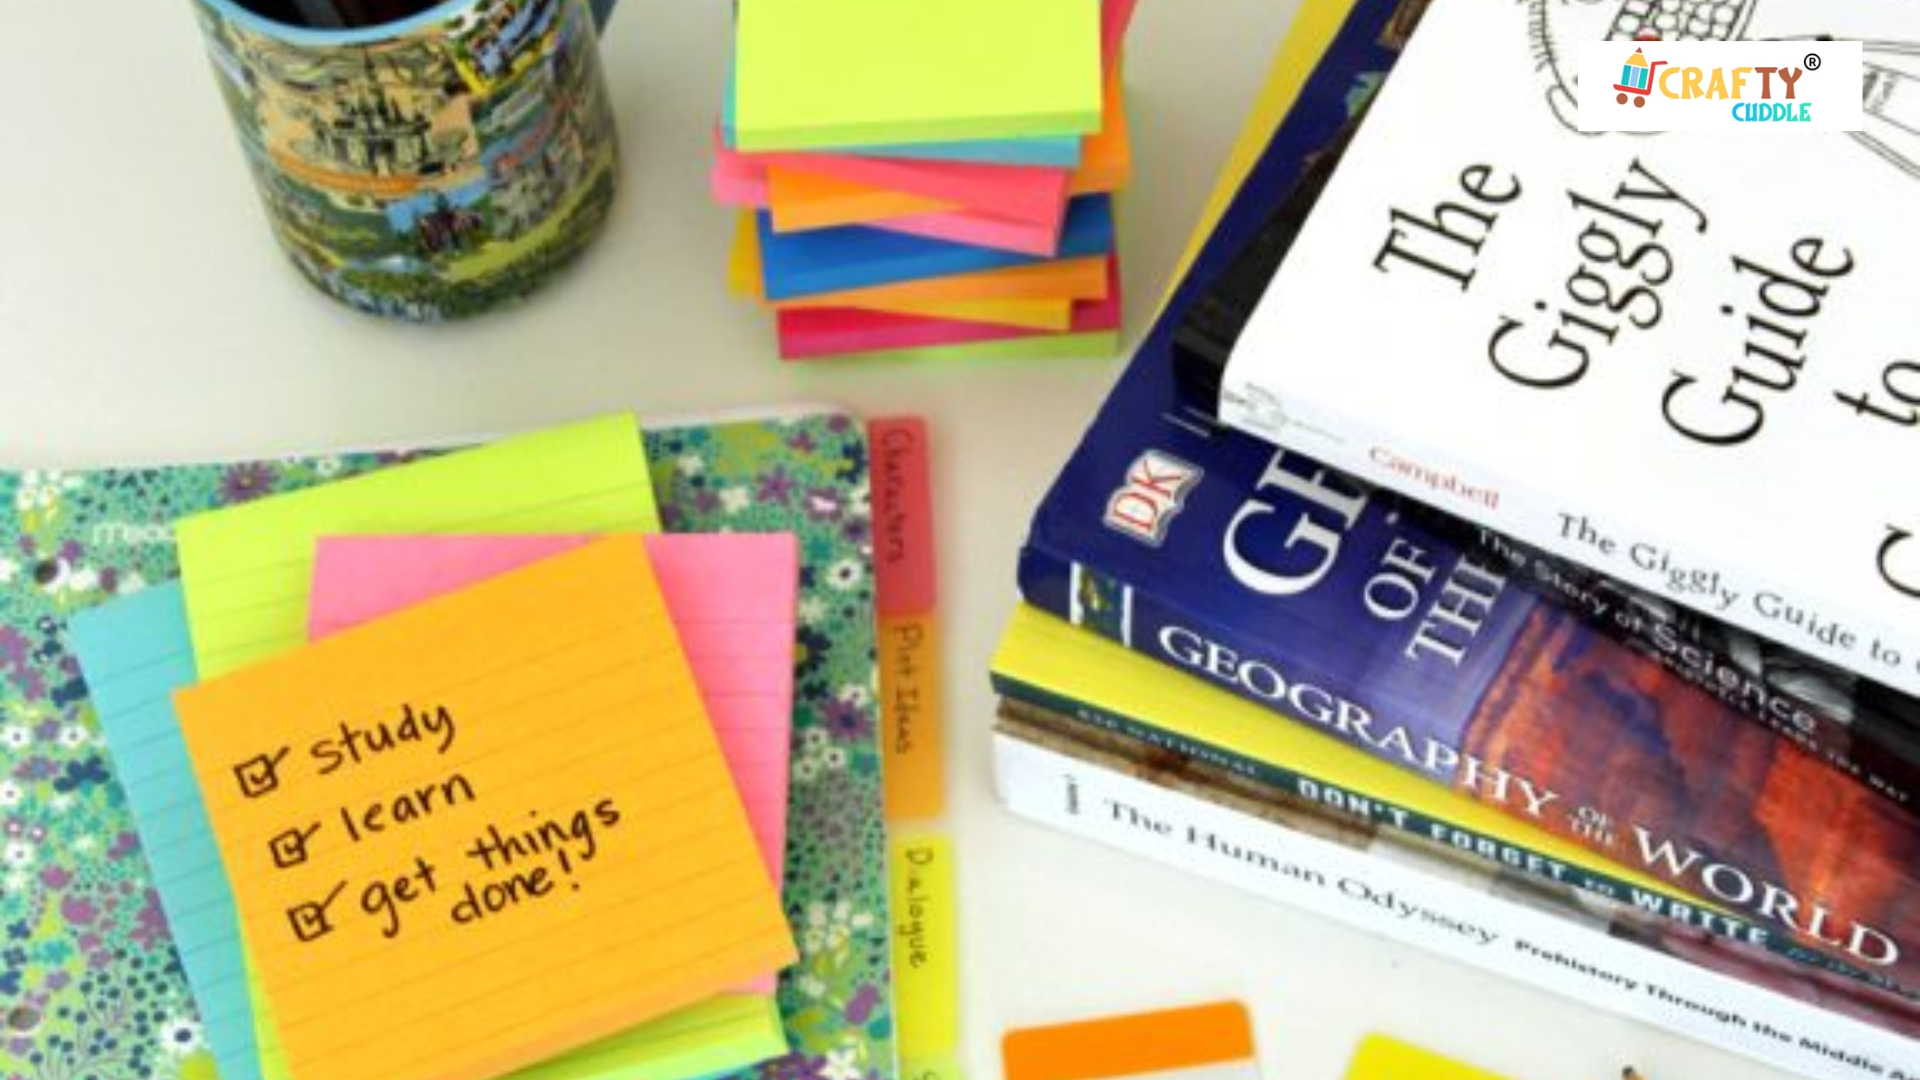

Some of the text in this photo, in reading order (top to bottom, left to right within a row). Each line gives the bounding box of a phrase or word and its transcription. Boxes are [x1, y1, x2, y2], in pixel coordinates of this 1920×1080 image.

[1372, 164, 1522, 292] The
[1488, 158, 1708, 389] Giggly
[1662, 237, 1854, 446] Guide
[1110, 458, 1184, 533] DK
[1368, 445, 1500, 510] Campbell
[1363, 539, 1438, 622] OF
[1559, 512, 1902, 668] The Giggly Guide to
[308, 702, 456, 776] study
[1654, 621, 1817, 734] Science
[339, 771, 476, 842] learn
[1158, 625, 1560, 818] GEOGRAPHY
[1631, 825, 1900, 966] WORLD
[360, 798, 621, 940] get things
[449, 848, 581, 926] done!
[897, 847, 934, 970] Dialogue
[1298, 776, 1408, 828] DON'T
[1431, 823, 1568, 881] FORGET
[1630, 887, 1771, 945] WRITE
[1103, 797, 1885, 1075] The Human Odyssey Prehistory Through the Middle
